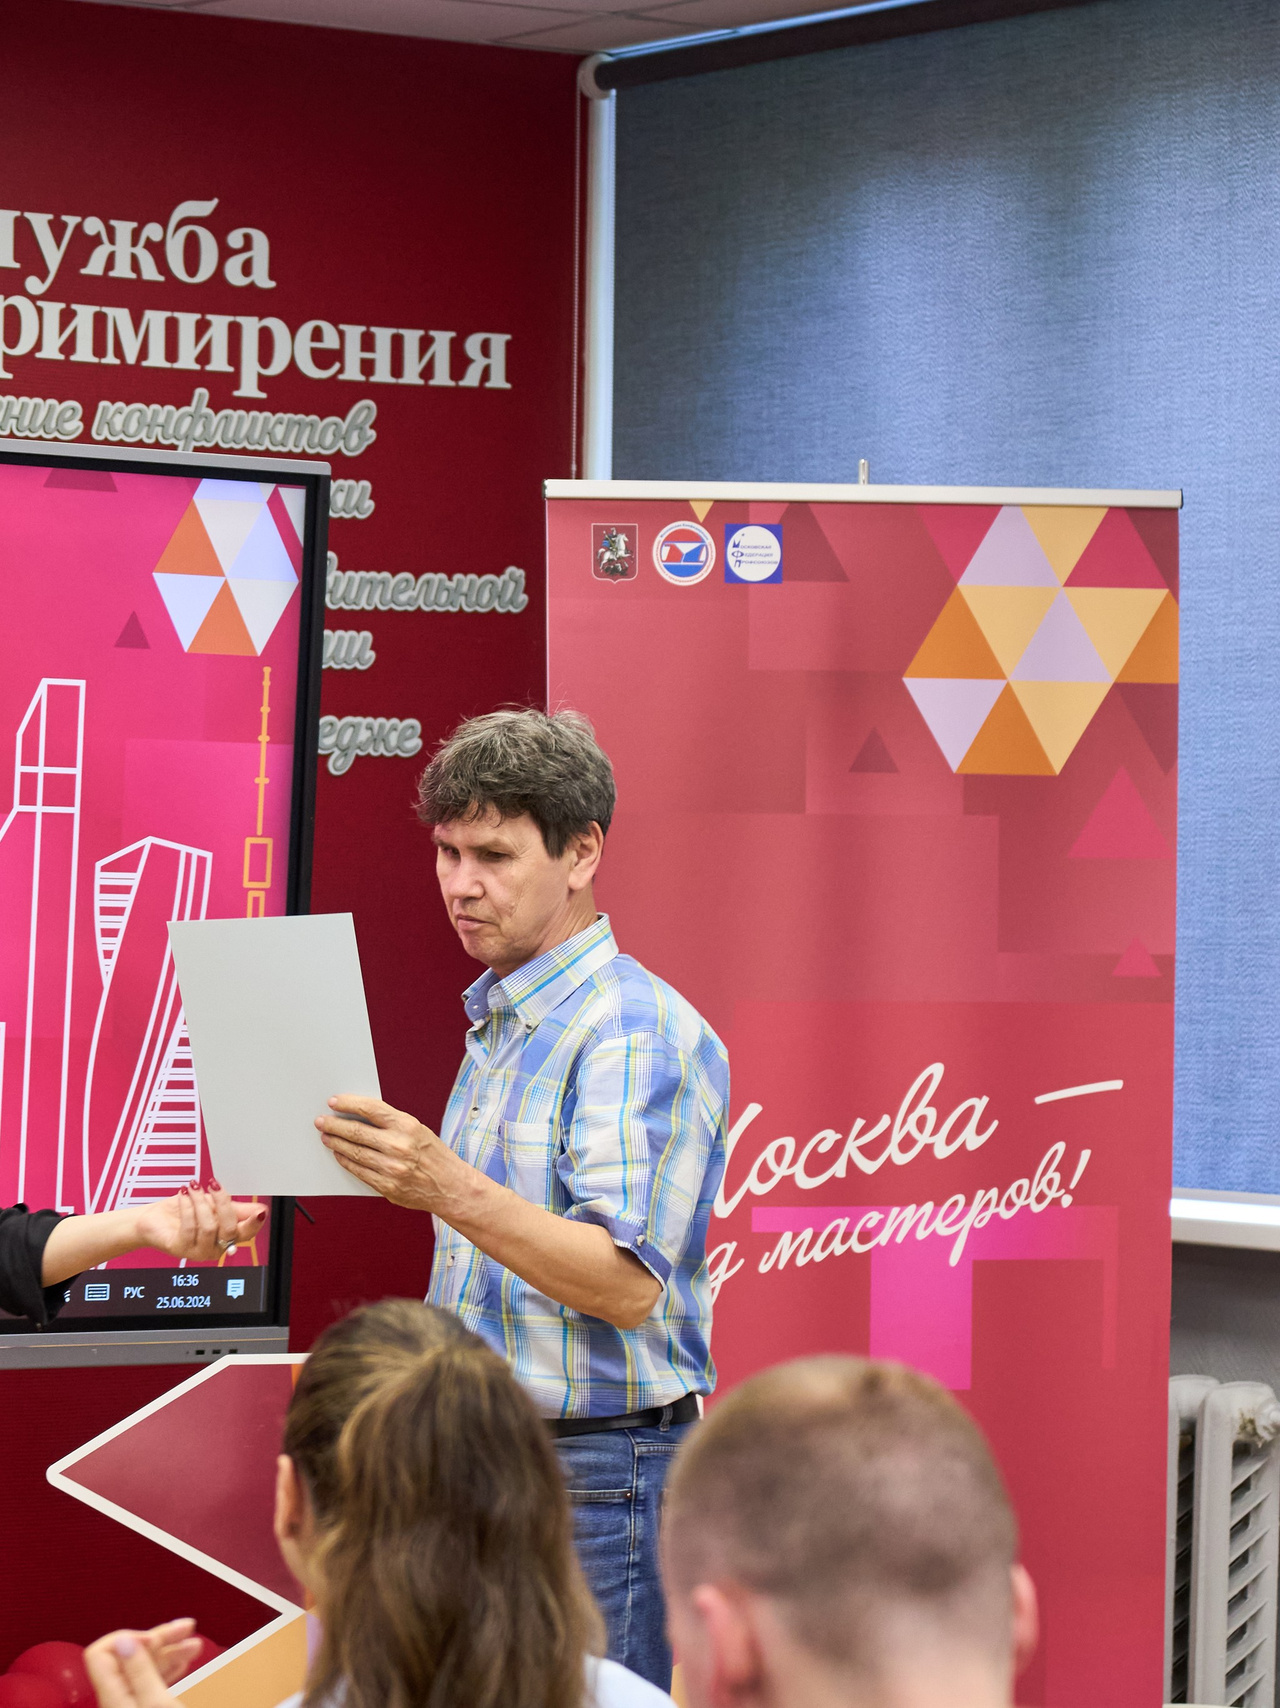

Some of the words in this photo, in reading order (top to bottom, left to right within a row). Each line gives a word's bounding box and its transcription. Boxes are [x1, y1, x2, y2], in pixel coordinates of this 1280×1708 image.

[92, 387, 377, 456] конфликтов
[757, 1141, 1092, 1274] мастеров!
[171, 1274, 199, 1287] 16:36
[123, 1286, 145, 1299] РУС
[156, 1296, 211, 1309] 25.06.2024
